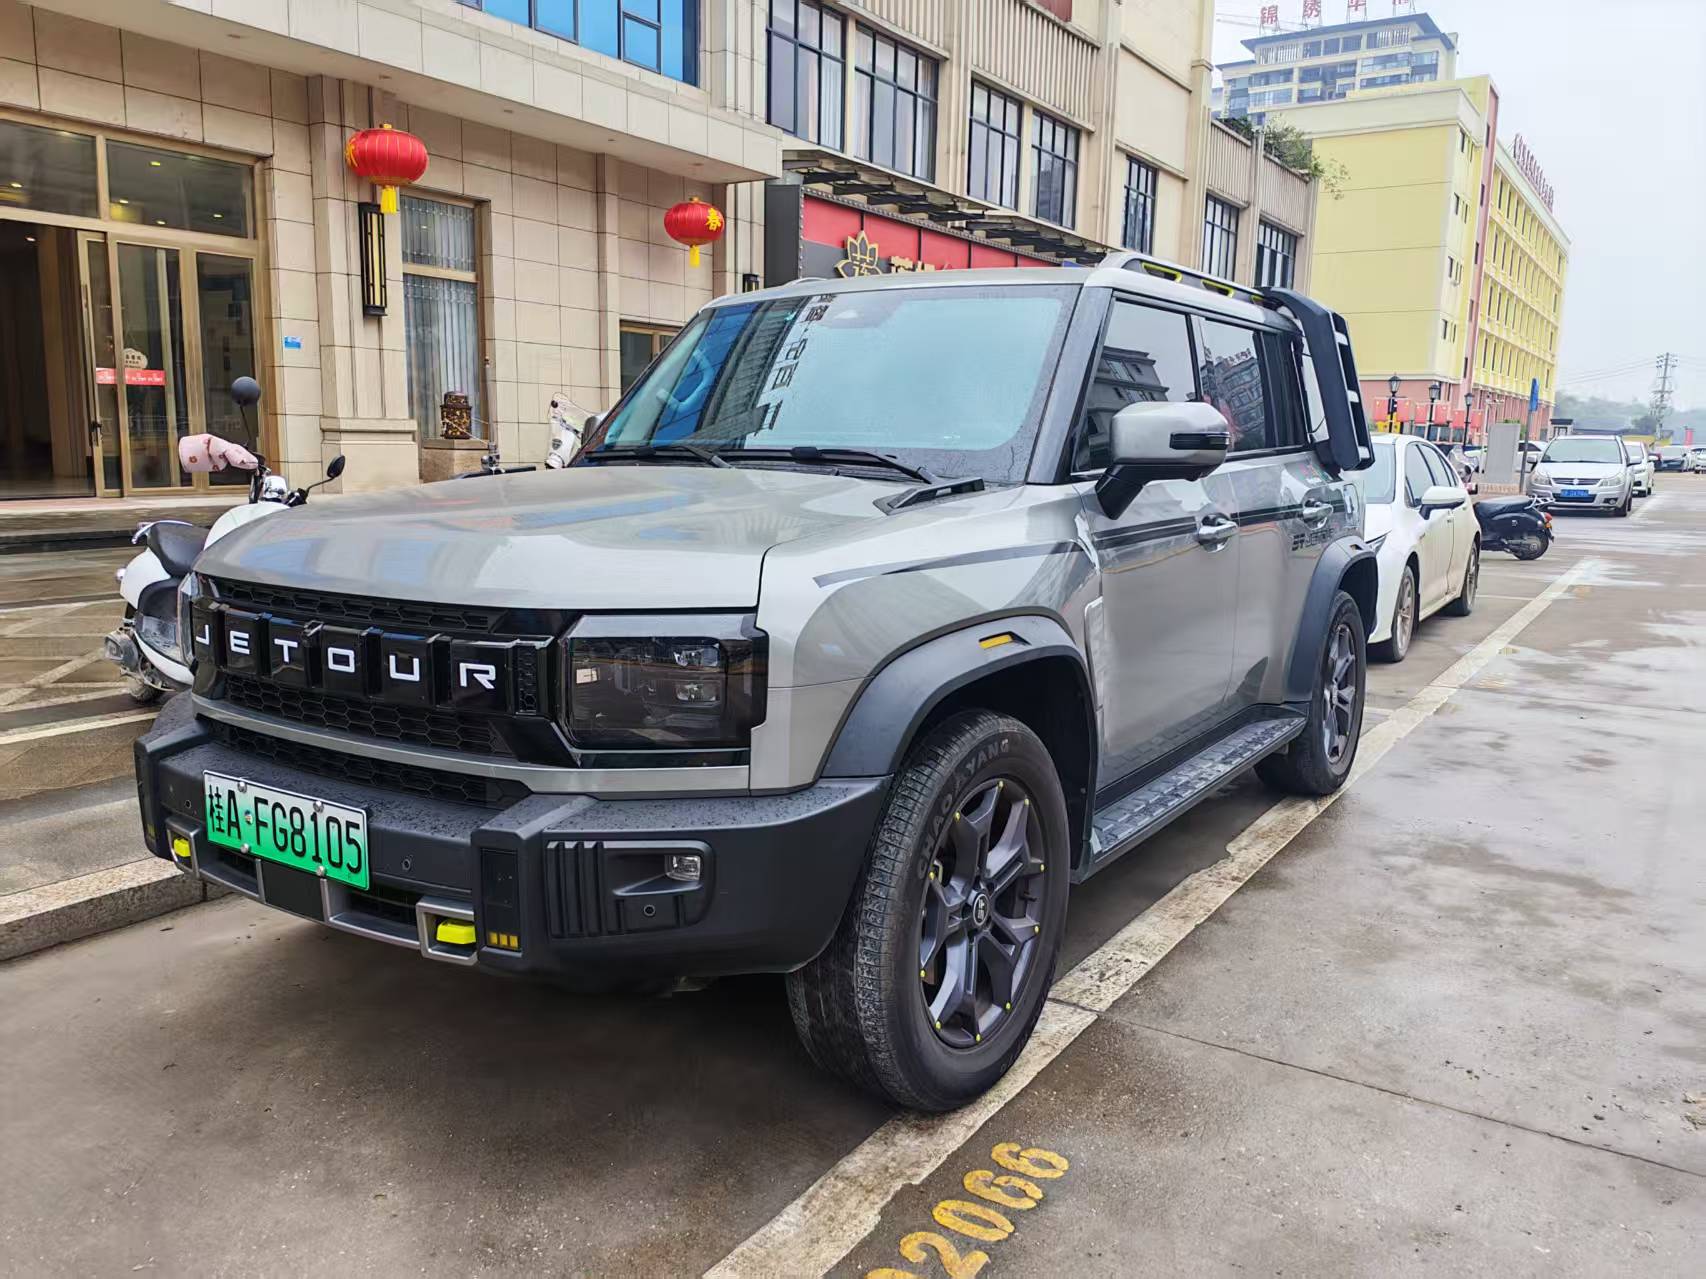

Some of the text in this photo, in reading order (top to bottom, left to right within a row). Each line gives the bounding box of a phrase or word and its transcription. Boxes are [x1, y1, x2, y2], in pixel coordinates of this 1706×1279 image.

[1260, 0, 1409, 25] 锦绣华
[705, 207, 722, 231] 春
[196, 623, 497, 690] JETOUR
[864, 1141, 1070, 1279] 2066
